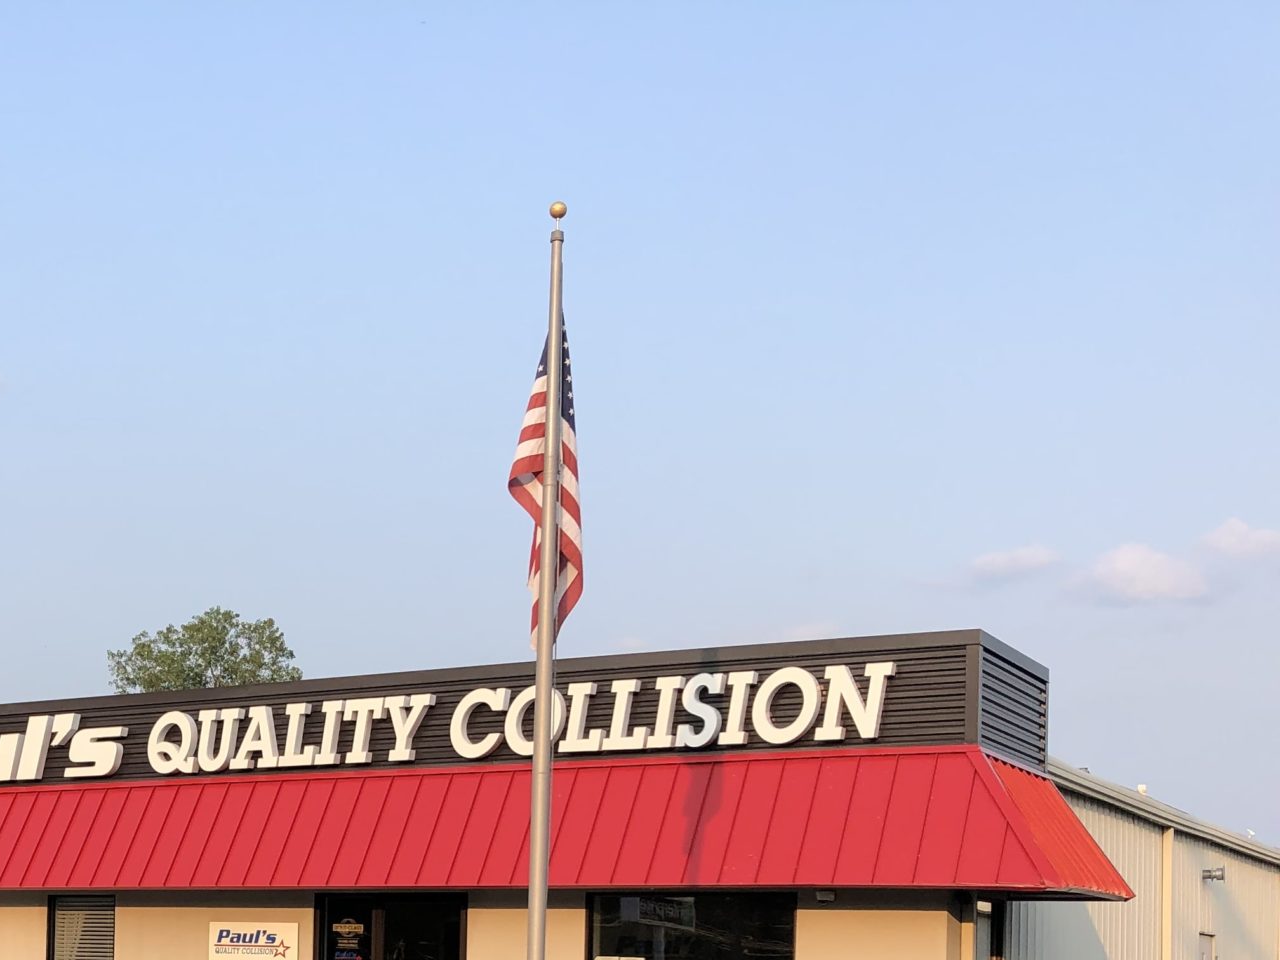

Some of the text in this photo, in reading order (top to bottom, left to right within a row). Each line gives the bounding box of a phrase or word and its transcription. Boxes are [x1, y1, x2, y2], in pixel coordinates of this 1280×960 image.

[147, 693, 436, 775] QUALITY
[449, 661, 896, 760] COLLISION
[216, 929, 277, 944] Paul's
[214, 947, 274, 955] QUALITY COLLISION
